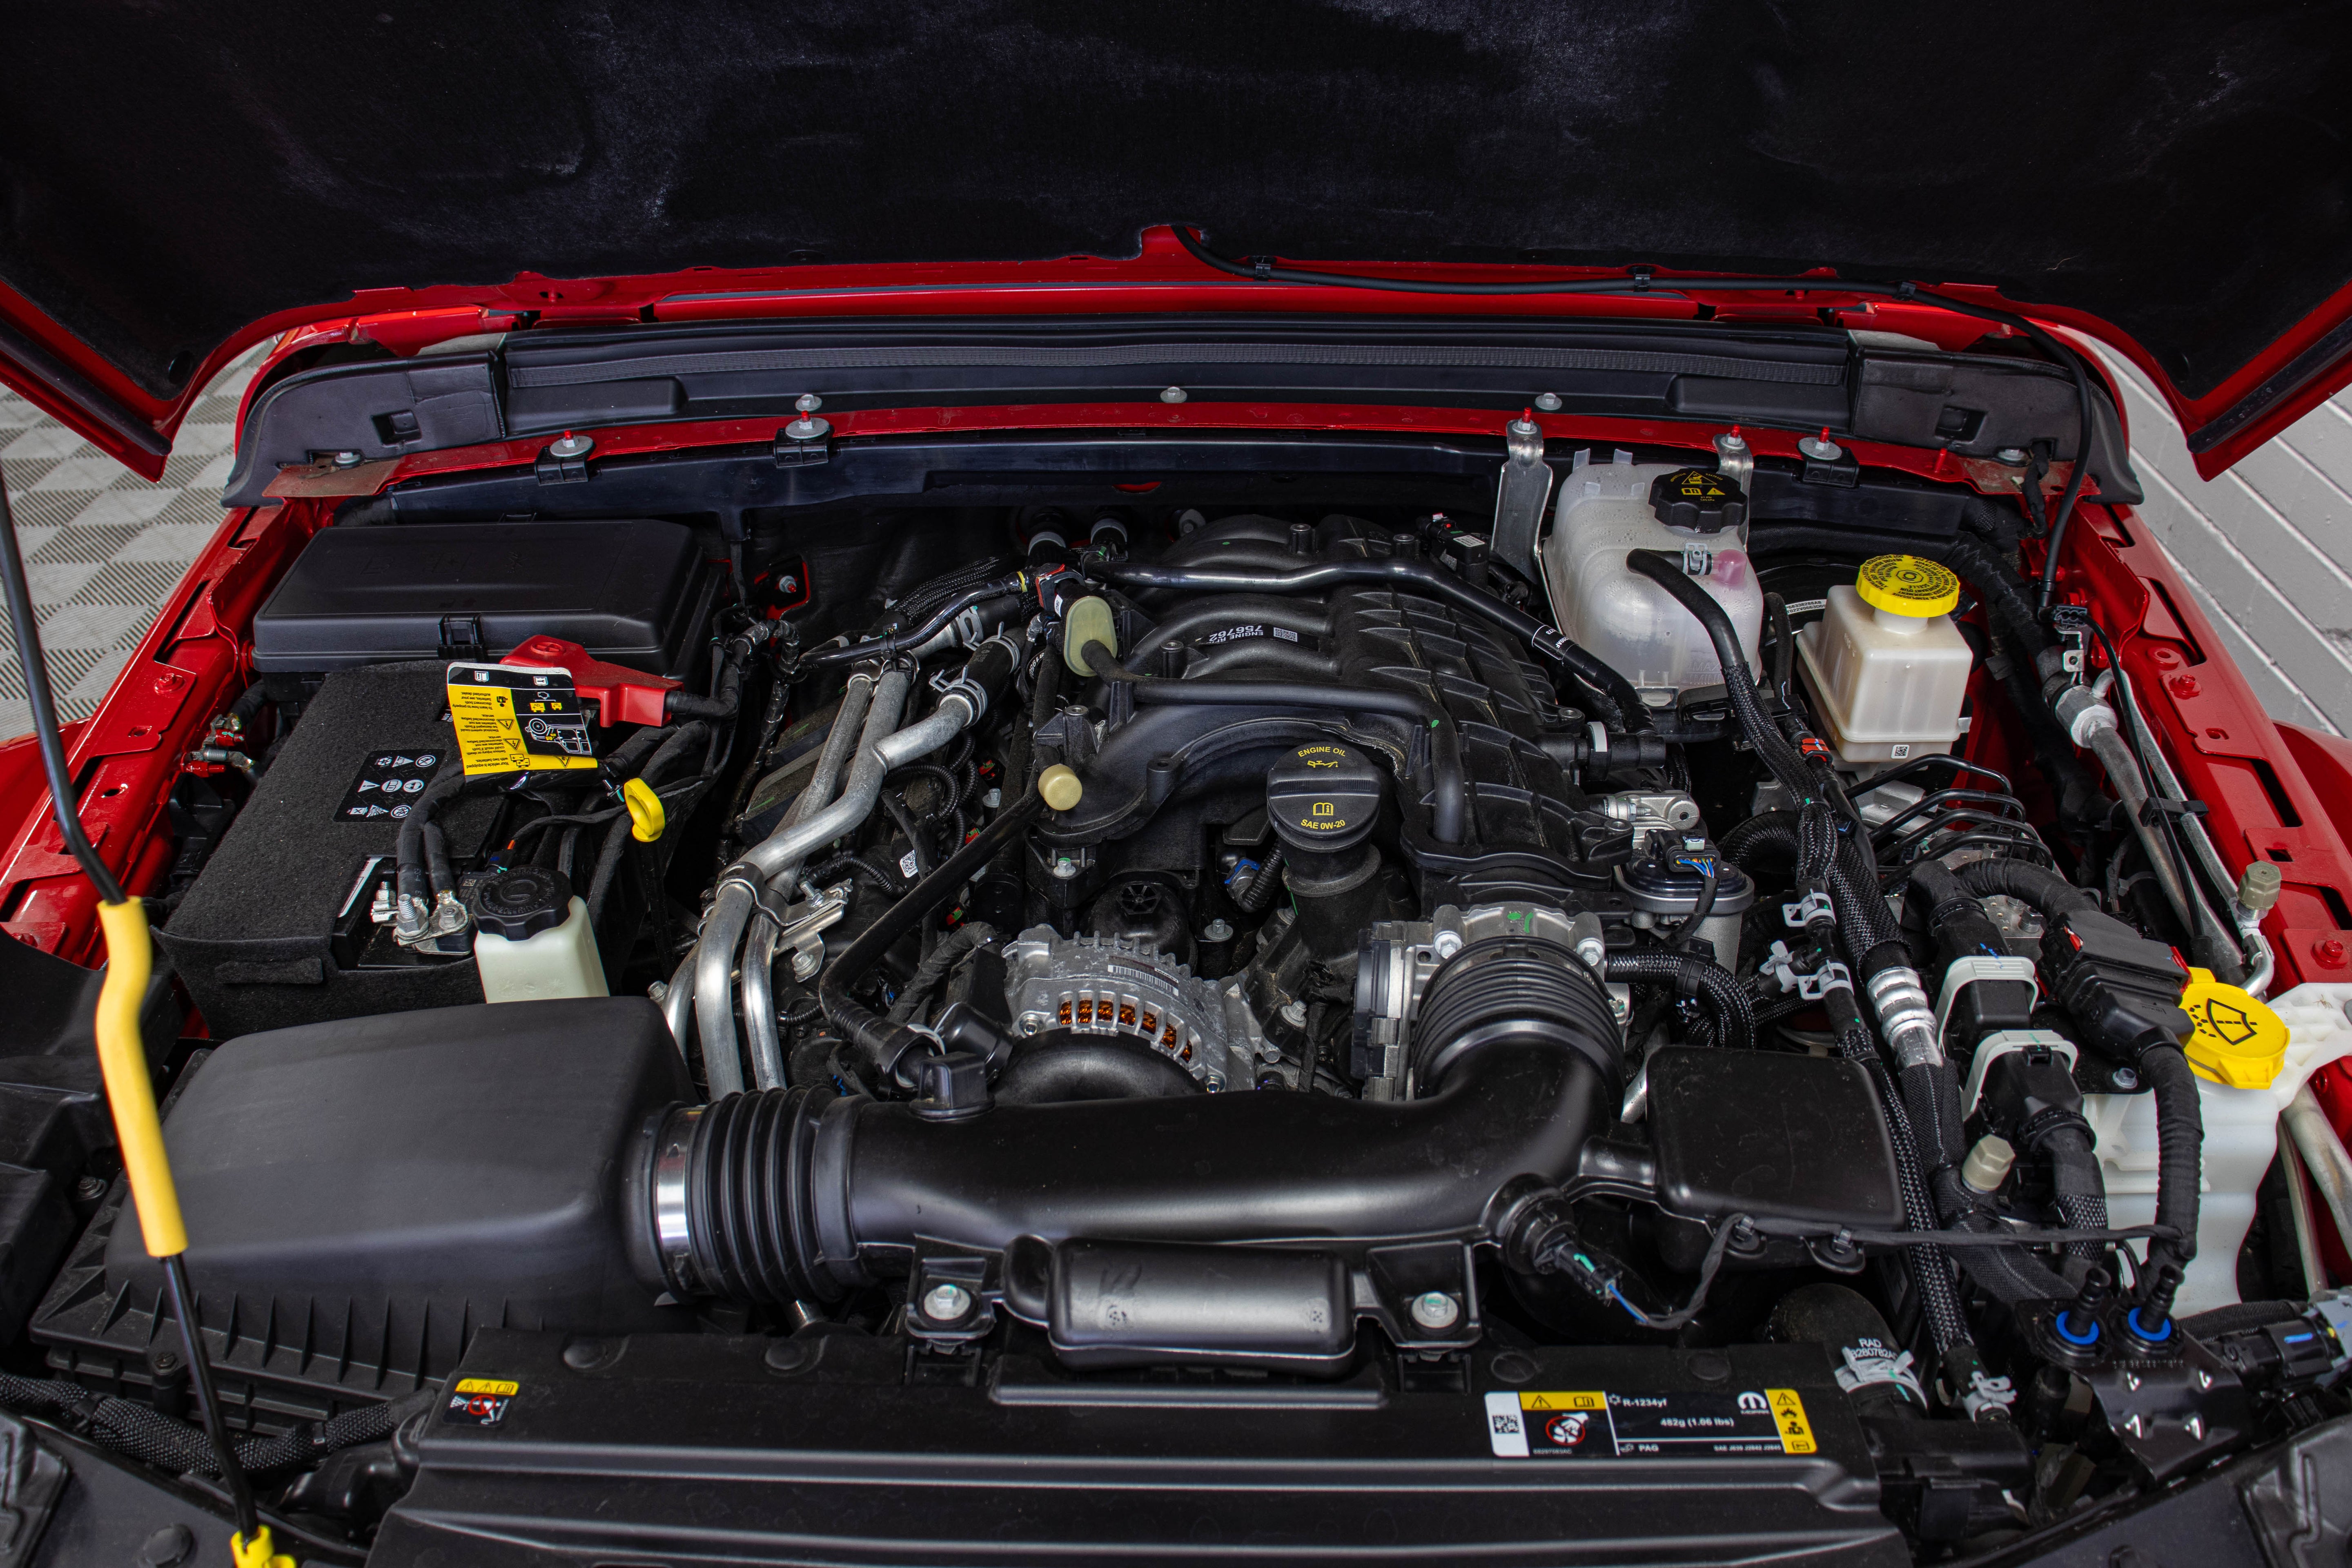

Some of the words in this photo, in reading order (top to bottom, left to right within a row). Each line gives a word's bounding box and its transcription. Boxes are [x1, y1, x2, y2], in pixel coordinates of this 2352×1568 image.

[1945, 572, 1957, 586] NETTOYER
[1936, 588, 1955, 598] BOUCHON
[1209, 625, 1263, 641] 756762
[1229, 631, 1263, 639] ENGINE
[1028, 652, 1045, 679] 81950
[1298, 746, 1331, 757] ENGINE
[1333, 748, 1346, 757] OIL
[1301, 820, 1319, 829] SAE
[1320, 819, 1345, 829] 0W-20
[1858, 1338, 1882, 1348] RAD
[1622, 1398, 1667, 1408] R-1234yf
[1660, 1418, 1686, 1428] 482g
[1687, 1417, 1712, 1428] (1.06
[1714, 1417, 1734, 1427] lbs)
